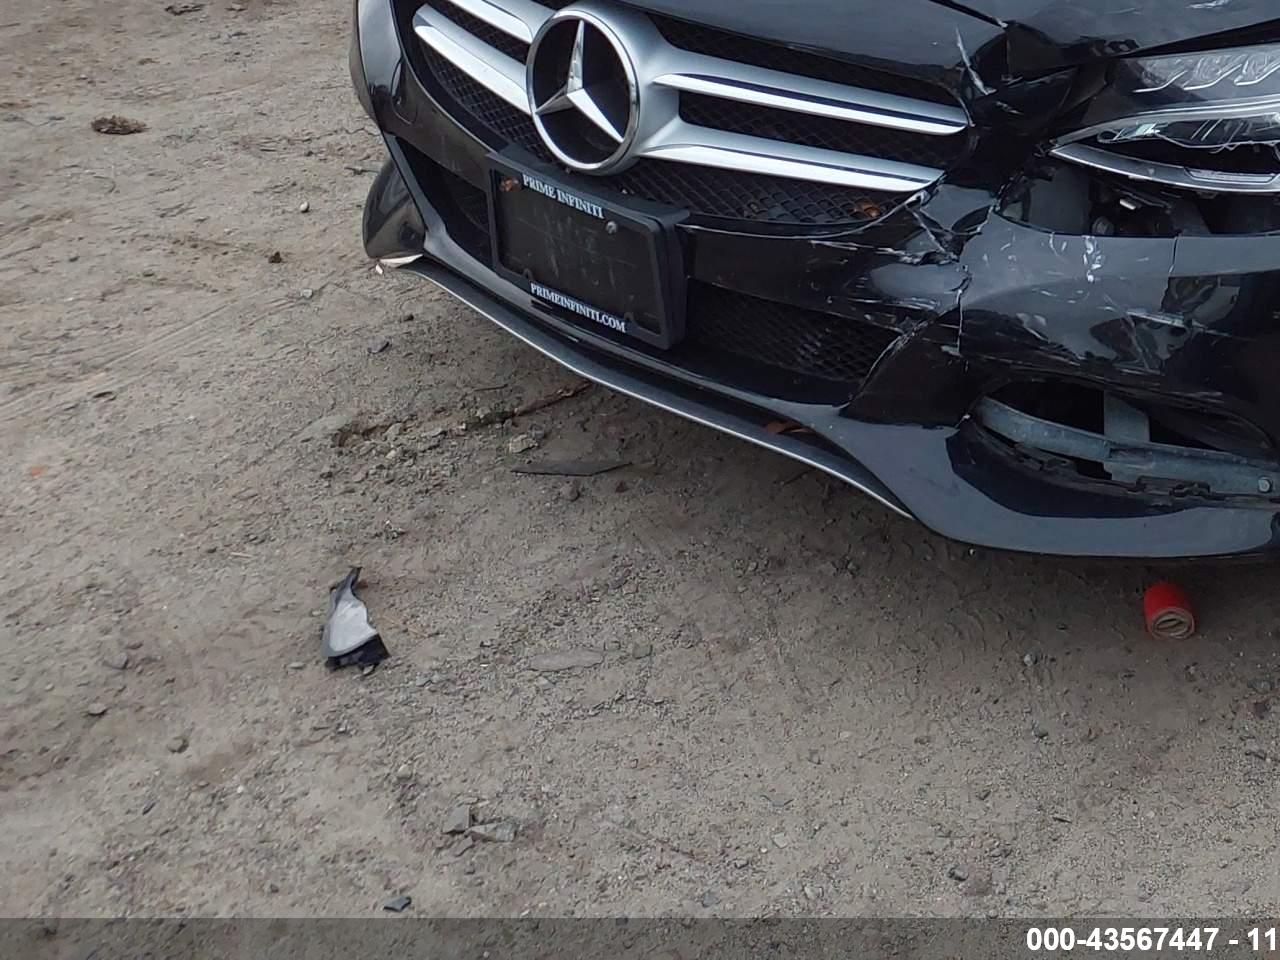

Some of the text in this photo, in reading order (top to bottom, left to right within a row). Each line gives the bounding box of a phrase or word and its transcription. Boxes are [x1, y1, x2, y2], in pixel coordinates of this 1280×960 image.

[522, 174, 604, 220] PRIME INFINITI
[530, 283, 627, 333] PRIMEINFINITI.COM
